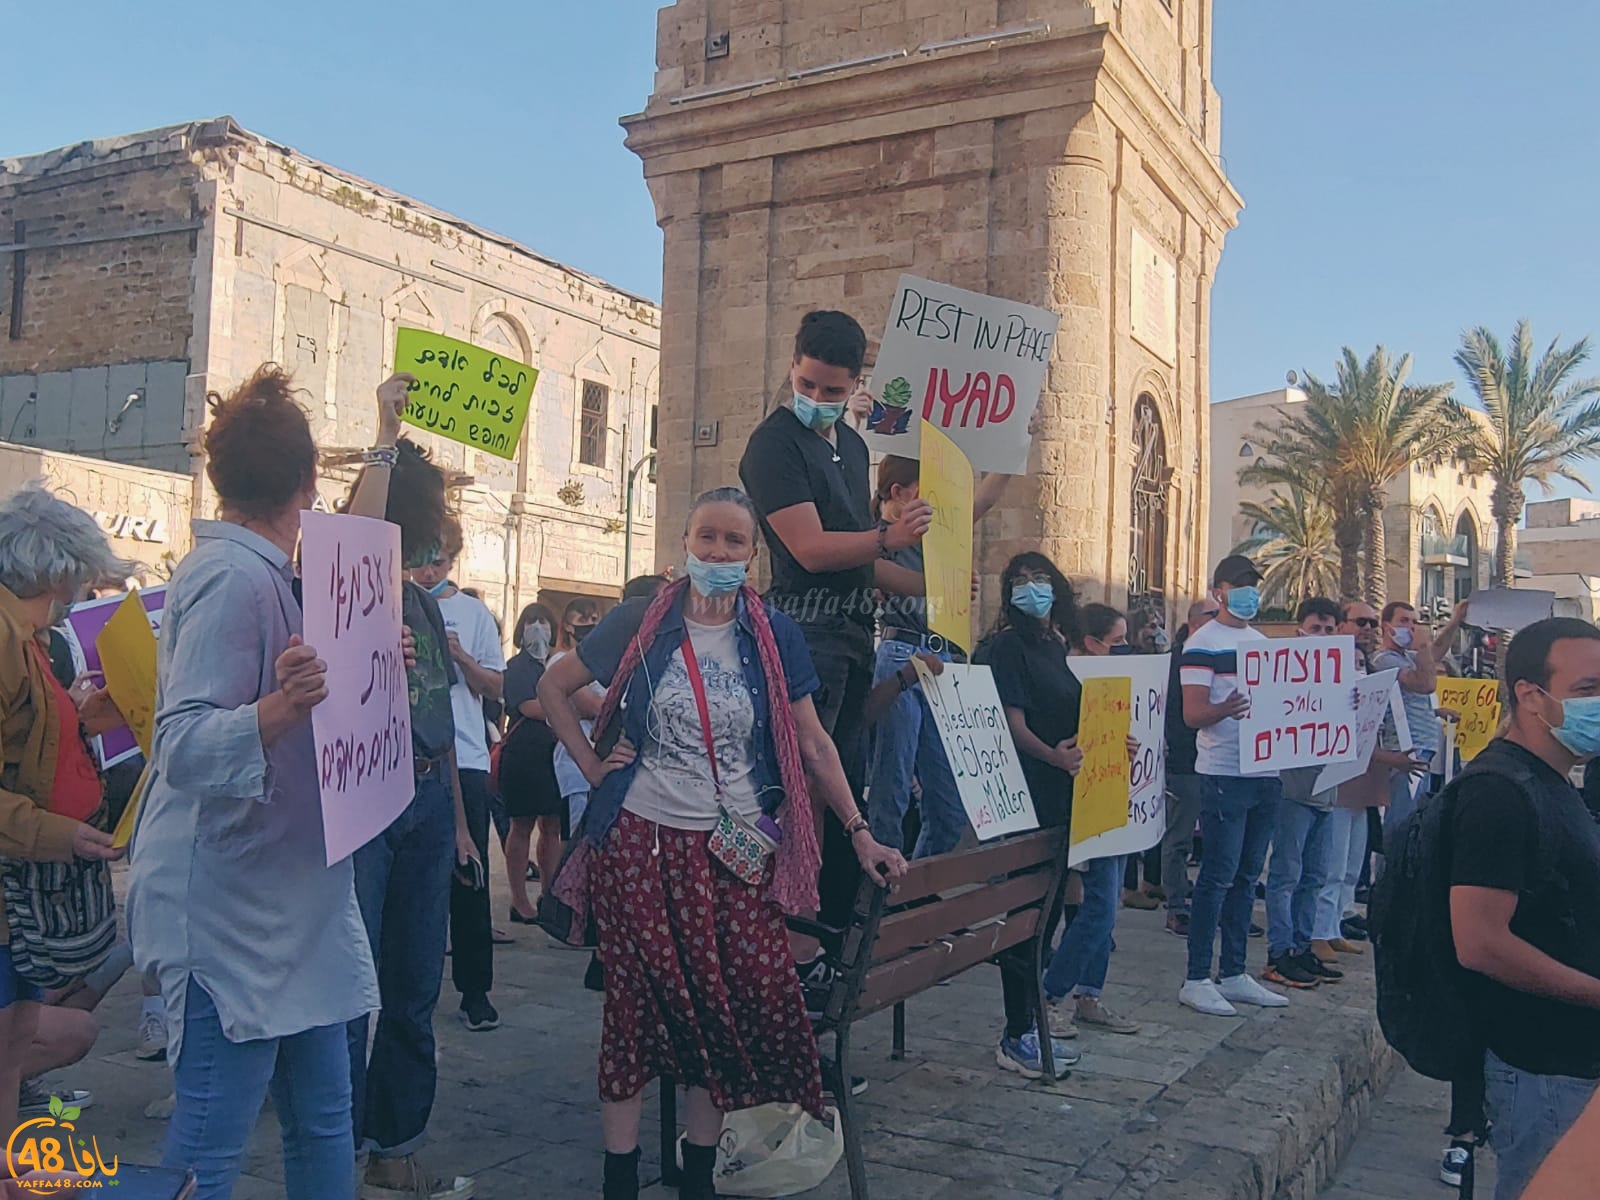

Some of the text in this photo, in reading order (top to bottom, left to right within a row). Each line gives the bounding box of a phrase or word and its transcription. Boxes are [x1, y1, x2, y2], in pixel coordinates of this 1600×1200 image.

[896, 288, 974, 344] REST
[973, 316, 1001, 350] IN
[414, 349, 527, 395] לכל אדם
[463, 394, 514, 423] זכות
[921, 367, 1016, 428] IYAD
[1245, 647, 1342, 686] רוצחים
[1476, 684, 1496, 707] 60
[956, 734, 1009, 777] Black
[982, 772, 1027, 825] Matter
